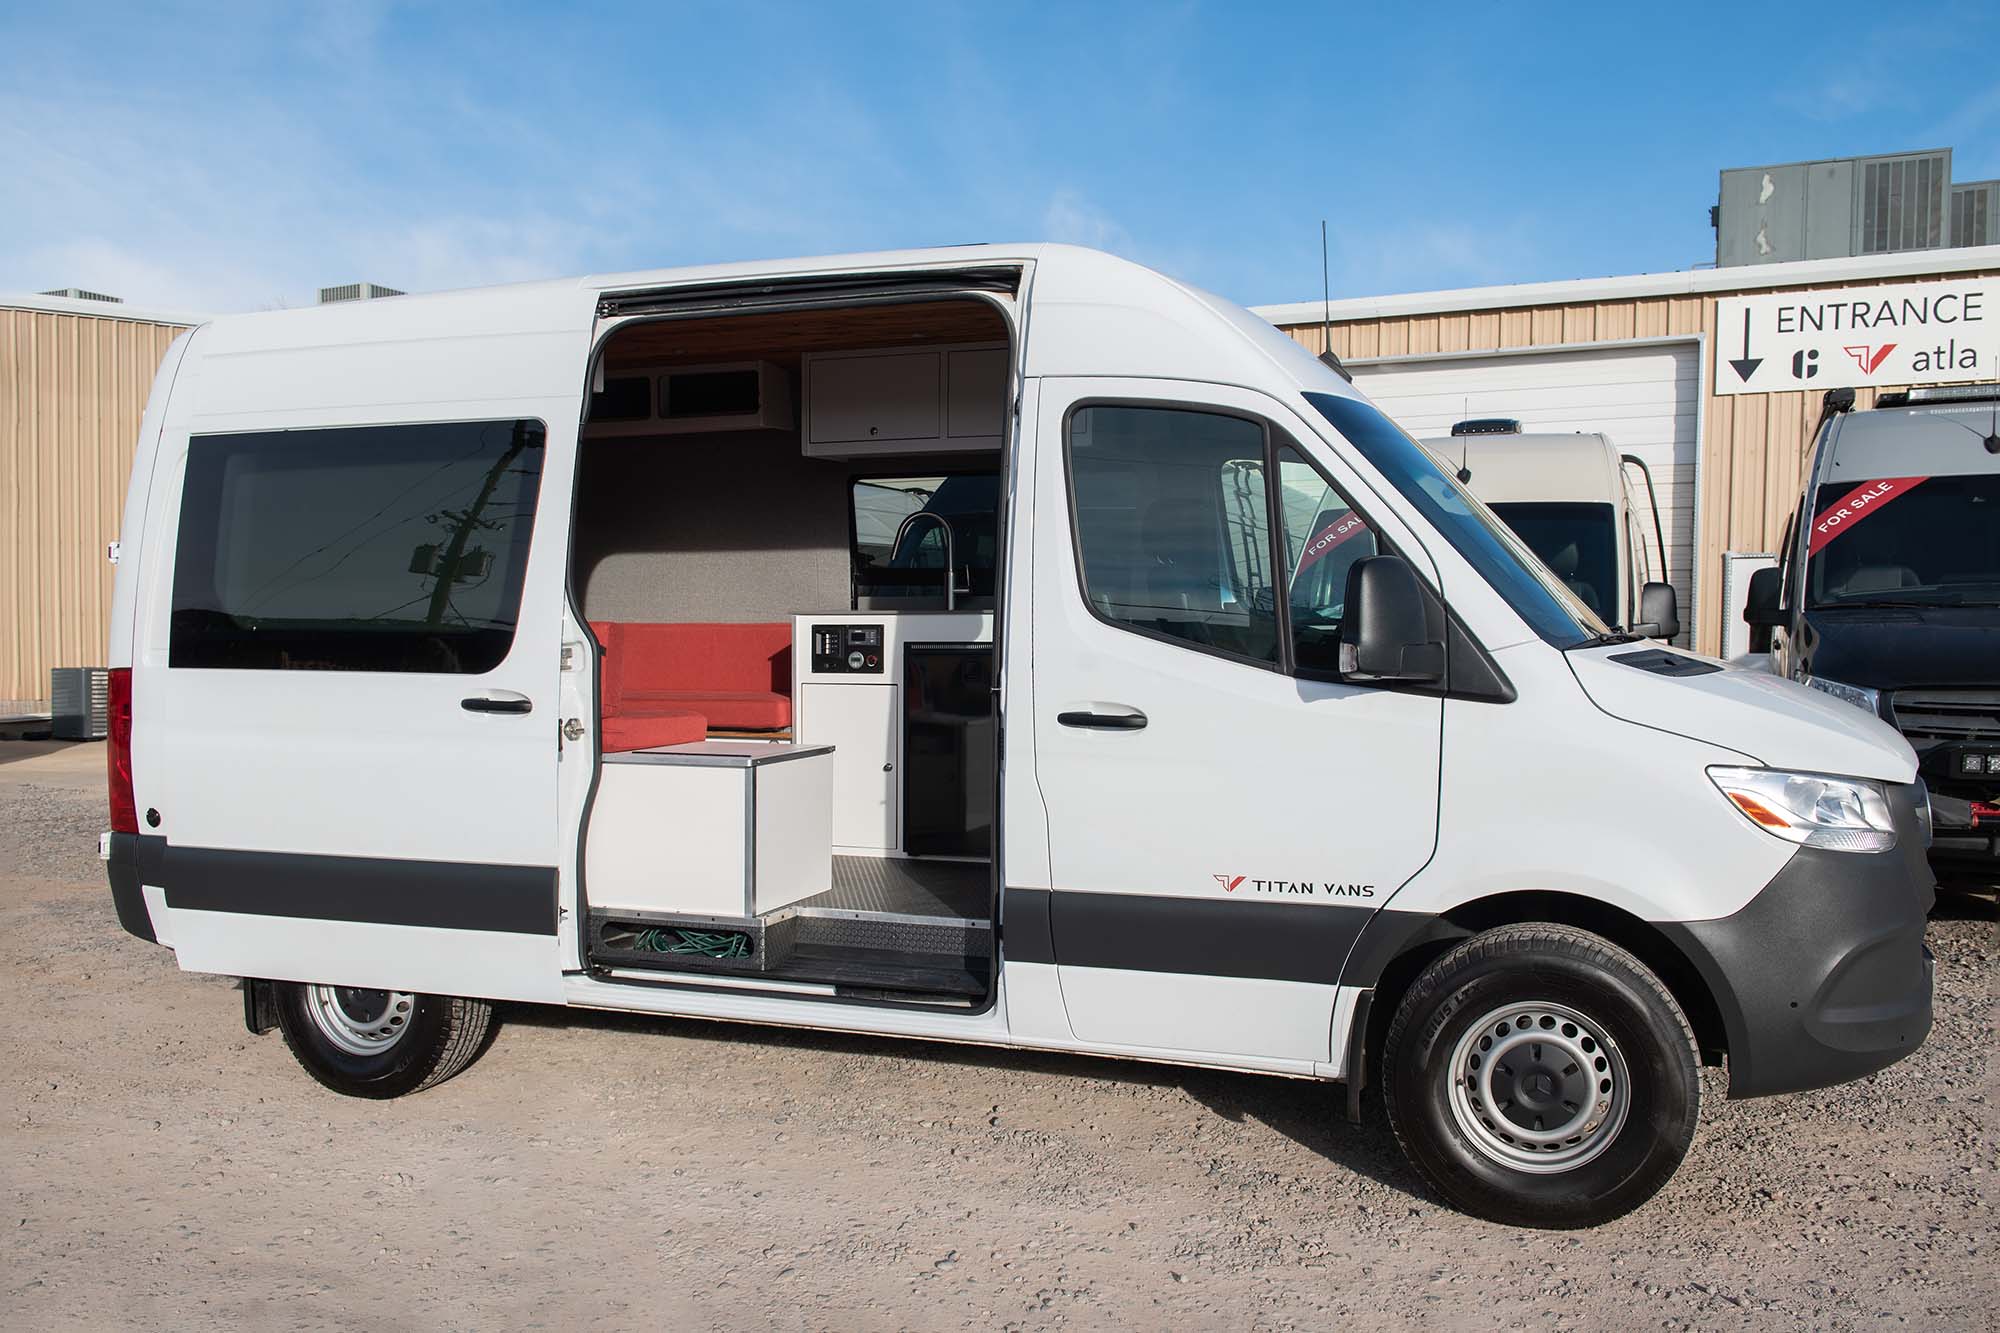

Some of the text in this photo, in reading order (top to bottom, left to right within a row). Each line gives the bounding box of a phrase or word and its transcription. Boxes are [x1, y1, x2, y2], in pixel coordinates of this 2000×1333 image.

[1777, 292, 1984, 334] ENTRANCE
[1912, 338, 1977, 372] atla
[1817, 481, 1894, 533] FOR SALE
[1308, 516, 1362, 555] FOR SAL
[1252, 880, 1375, 897] TITAN VANS
